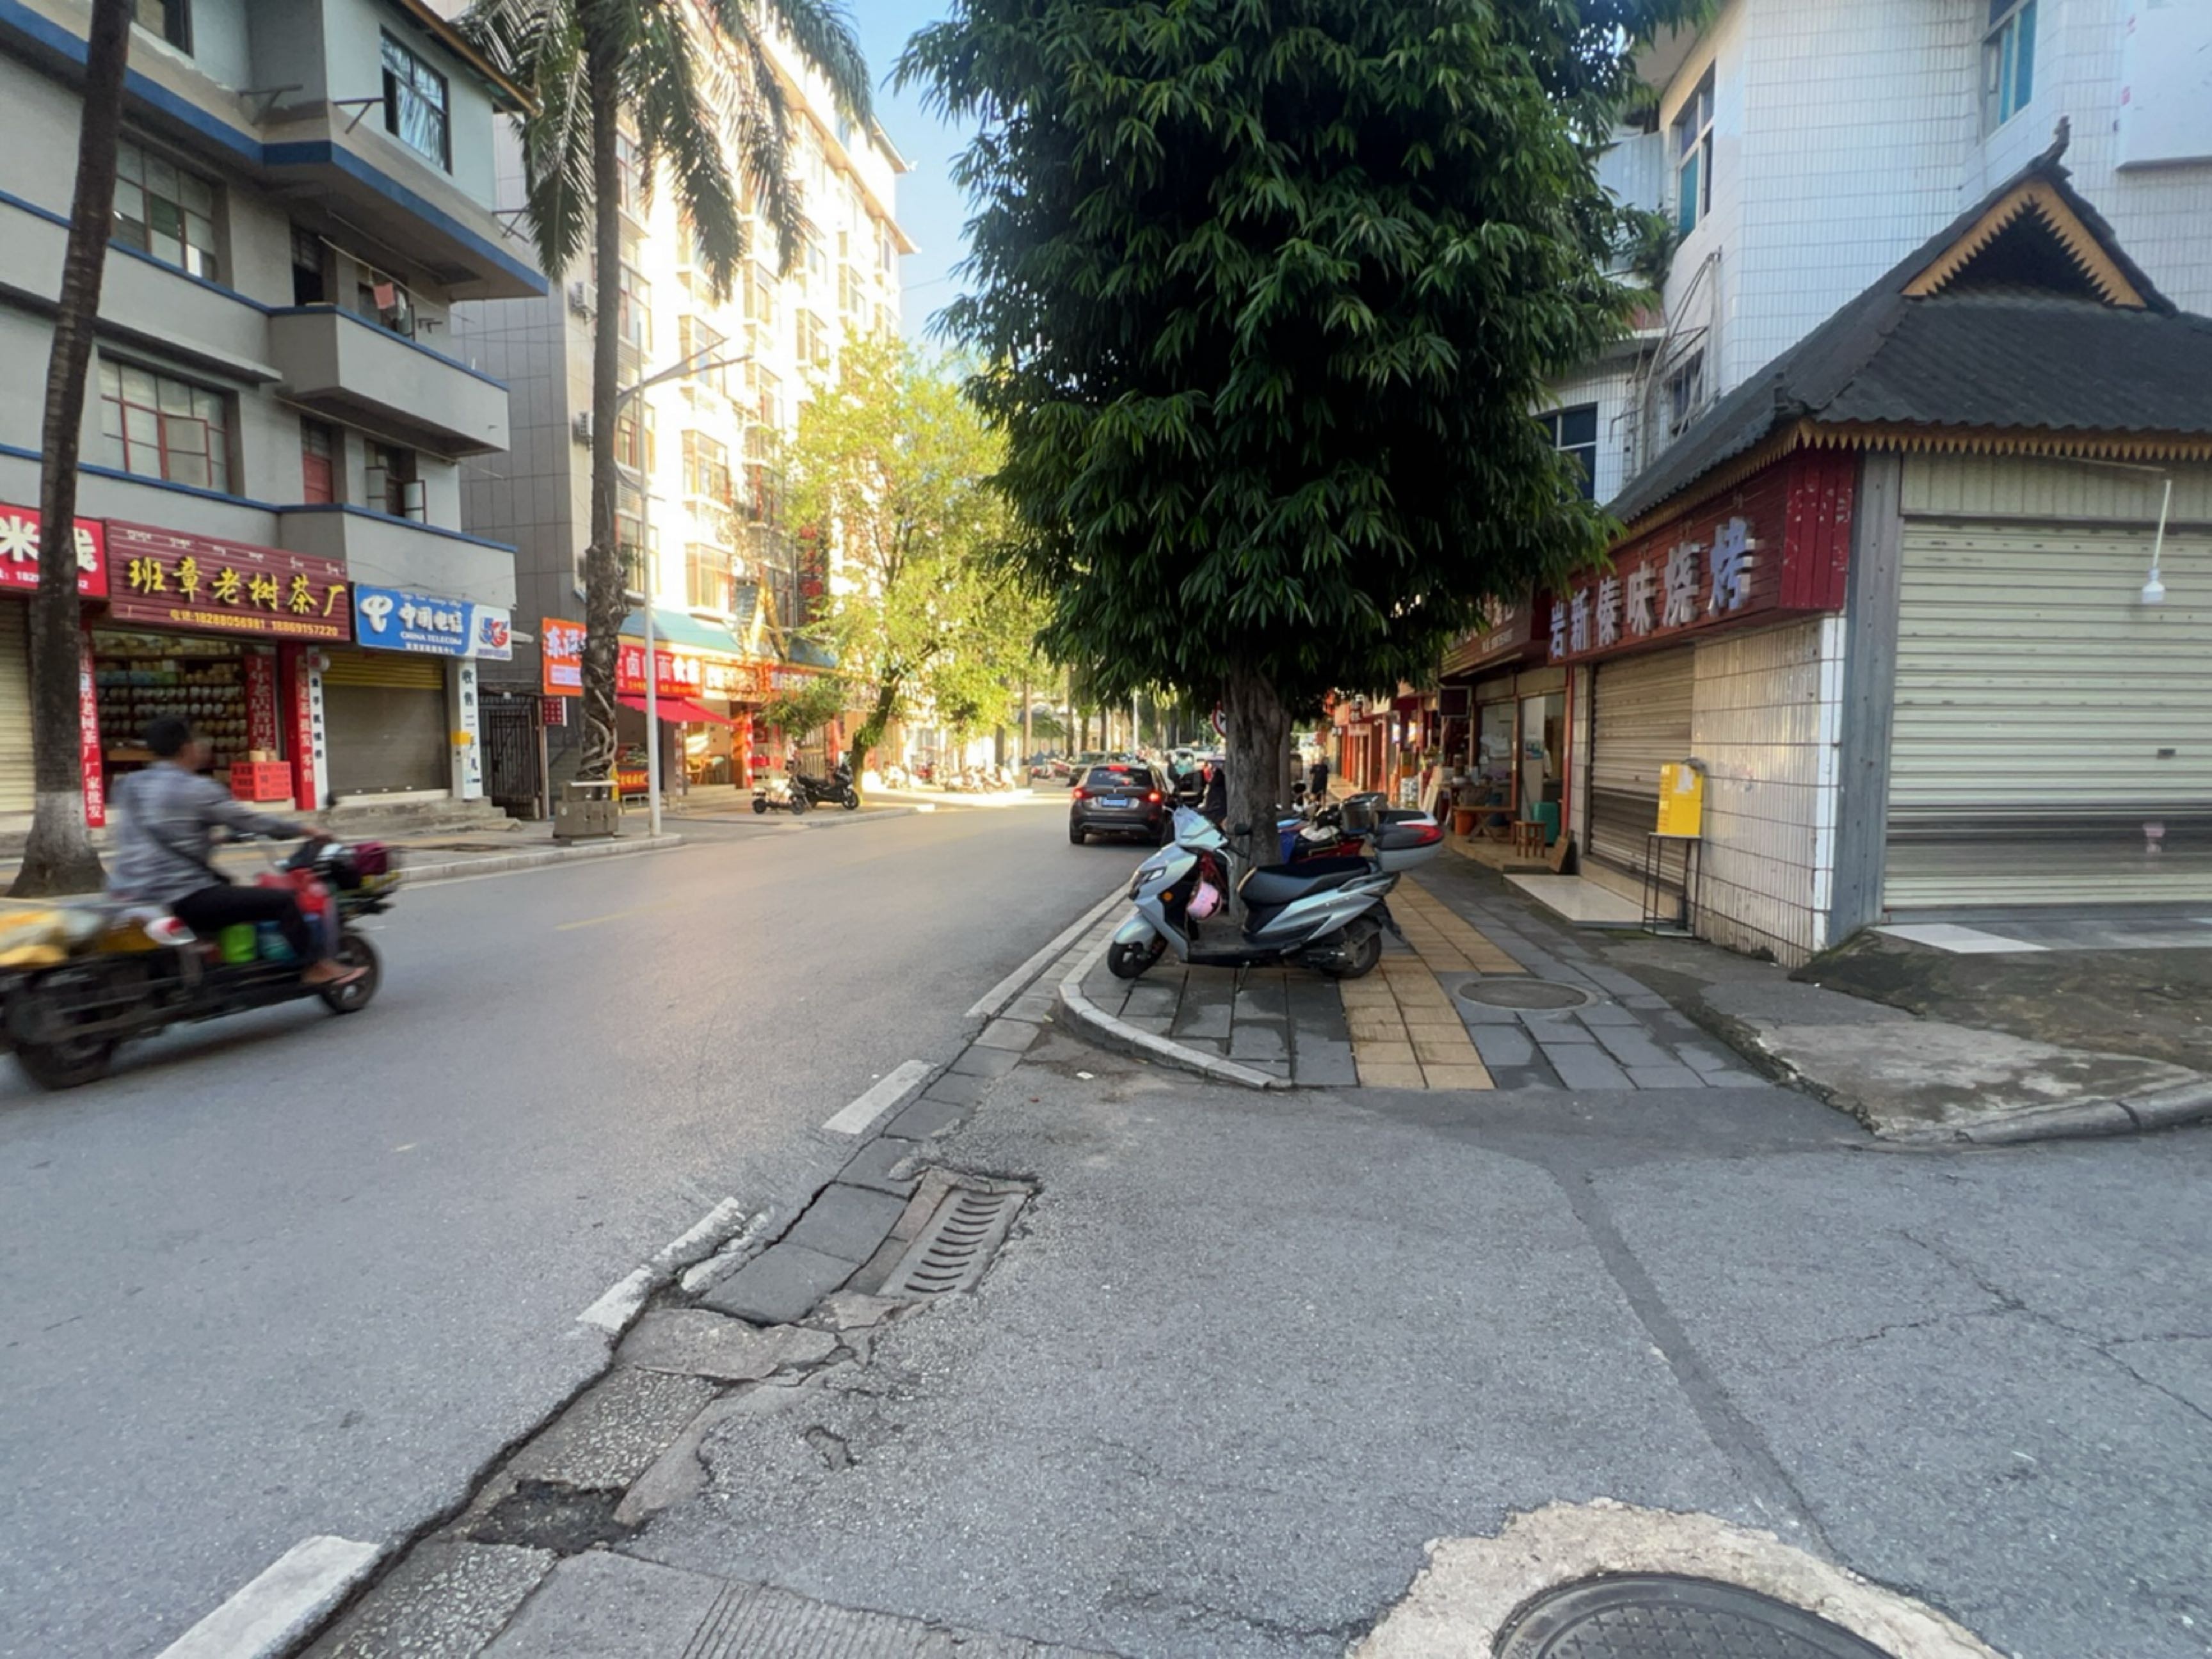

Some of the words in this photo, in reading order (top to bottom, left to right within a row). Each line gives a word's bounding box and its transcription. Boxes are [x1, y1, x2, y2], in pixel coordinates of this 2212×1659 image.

[128, 556, 346, 618] 班章老树茶厂
[399, 602, 463, 633] 中国电信
[400, 630, 426, 642] CHINA
[428, 633, 462, 646] TELECOM
